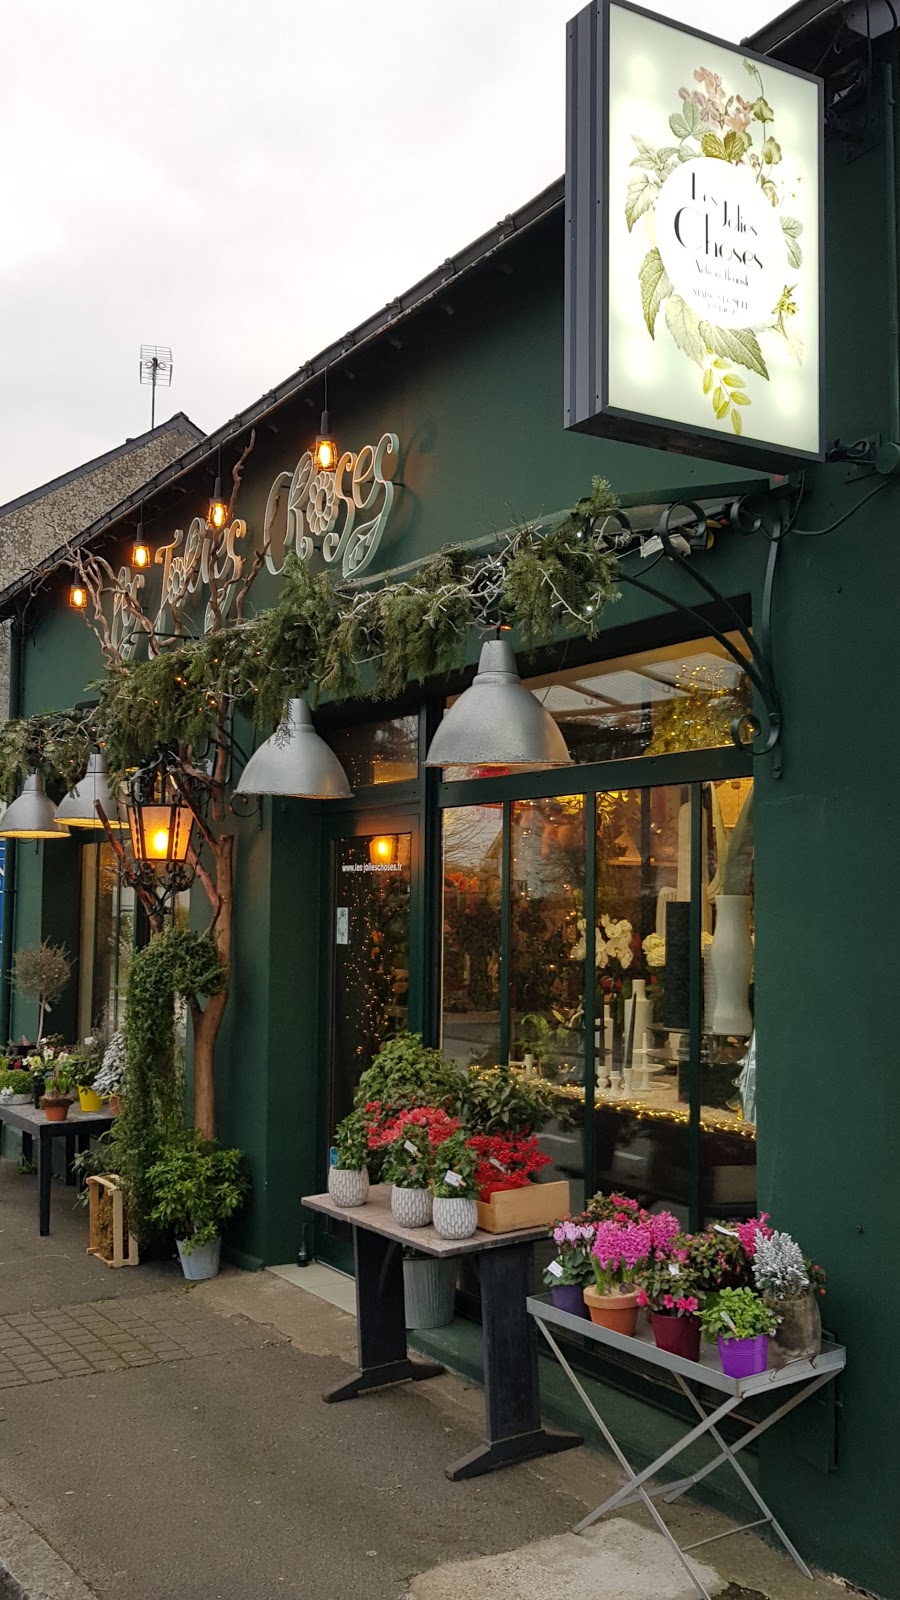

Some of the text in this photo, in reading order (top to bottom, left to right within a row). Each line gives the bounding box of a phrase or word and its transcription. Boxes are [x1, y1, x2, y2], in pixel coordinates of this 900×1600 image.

[674, 207, 762, 269] Choses
[723, 200, 758, 236] Jolies
[263, 432, 400, 579] Choses
